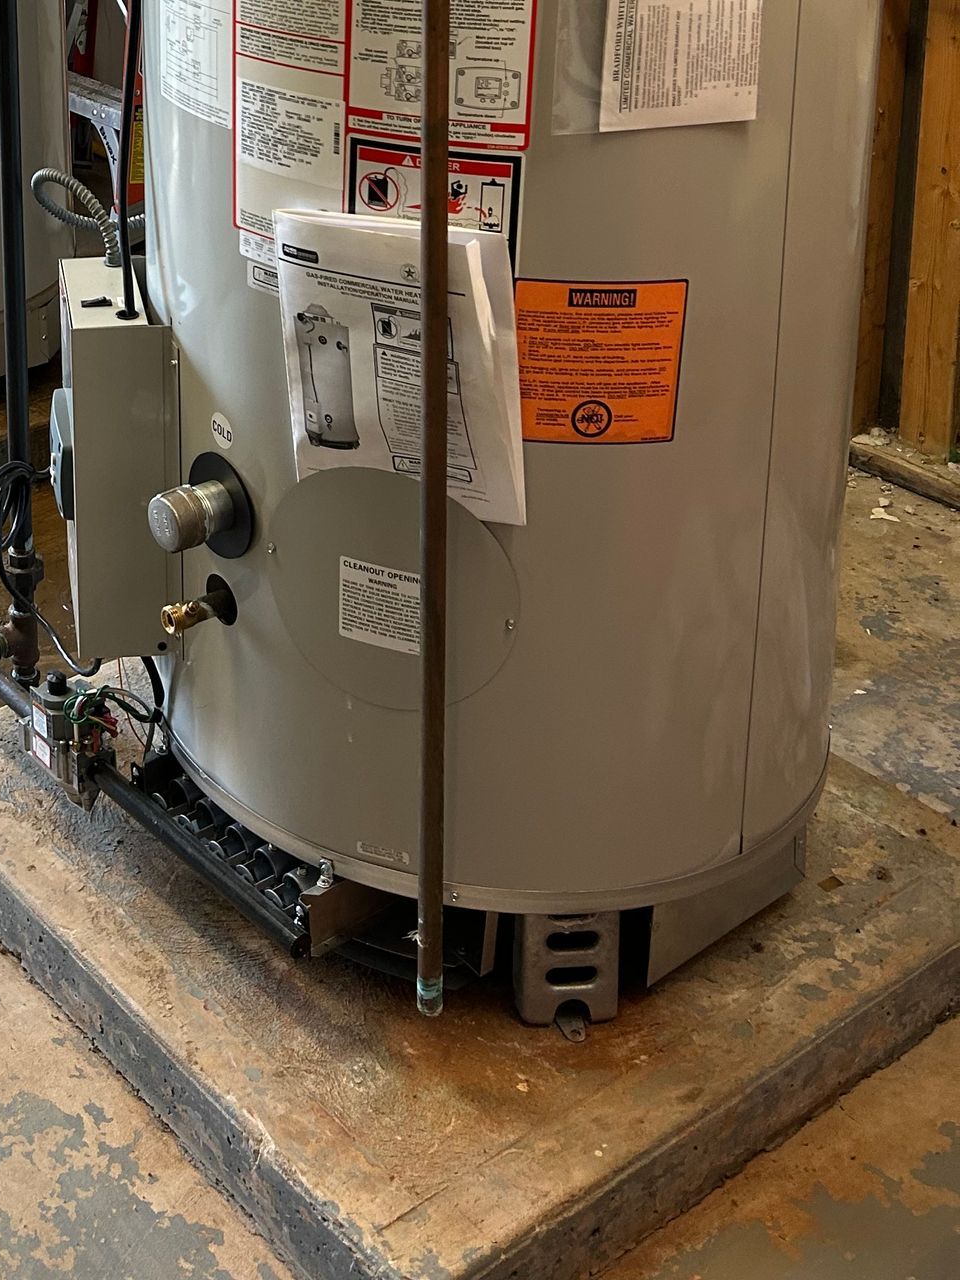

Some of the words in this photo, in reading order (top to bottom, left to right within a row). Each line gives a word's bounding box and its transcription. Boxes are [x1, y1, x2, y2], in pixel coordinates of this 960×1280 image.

[617, 0, 626, 29] WHITE
[630, 0, 638, 26] WATER
[612, 32, 623, 81] BRADFORD
[625, 29, 635, 78] COMMERCIAL
[622, 80, 631, 109] LIMITED
[306, 272, 337, 284] GAS-FIRED
[338, 278, 380, 291] COMMERCIAL
[381, 286, 403, 295] WATER
[404, 290, 421, 298] HEAT
[394, 295, 419, 305] MANUAL
[572, 292, 634, 306] WARNING!
[212, 420, 232, 442] COLD
[343, 560, 385, 576] CLEANOUT
[368, 578, 397, 589] WARNING
